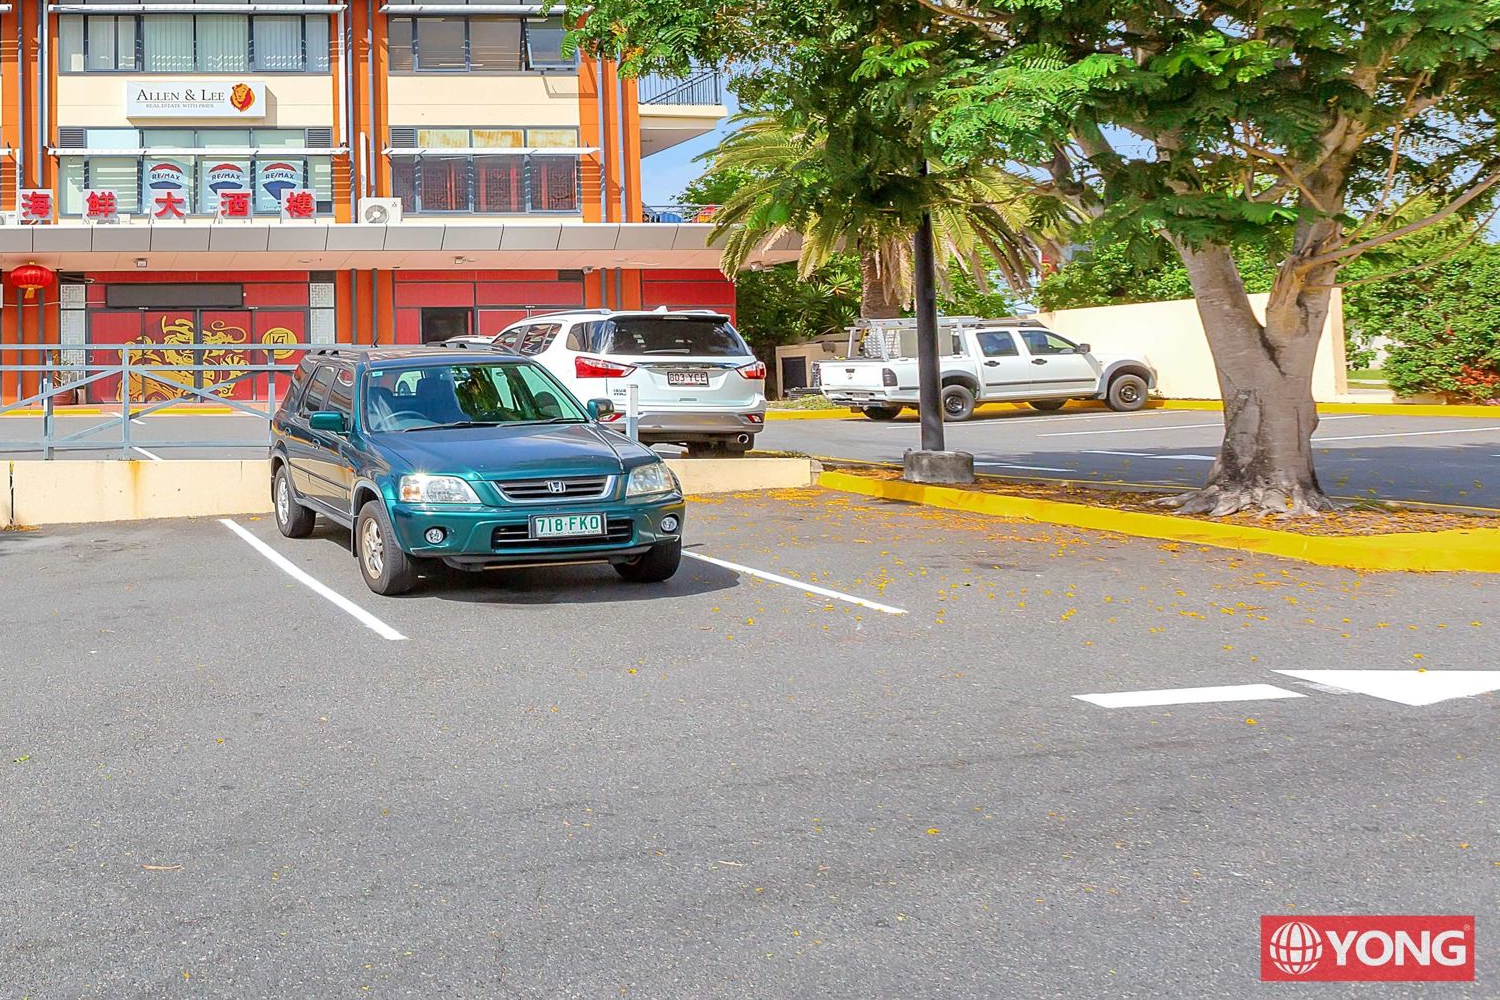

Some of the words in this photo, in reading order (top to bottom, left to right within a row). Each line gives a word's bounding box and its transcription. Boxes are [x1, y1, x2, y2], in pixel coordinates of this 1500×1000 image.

[184, 88, 195, 101] &
[151, 172, 181, 181] RE/MAX
[211, 172, 241, 181] RE/MAX
[265, 172, 295, 181] RE/MAX
